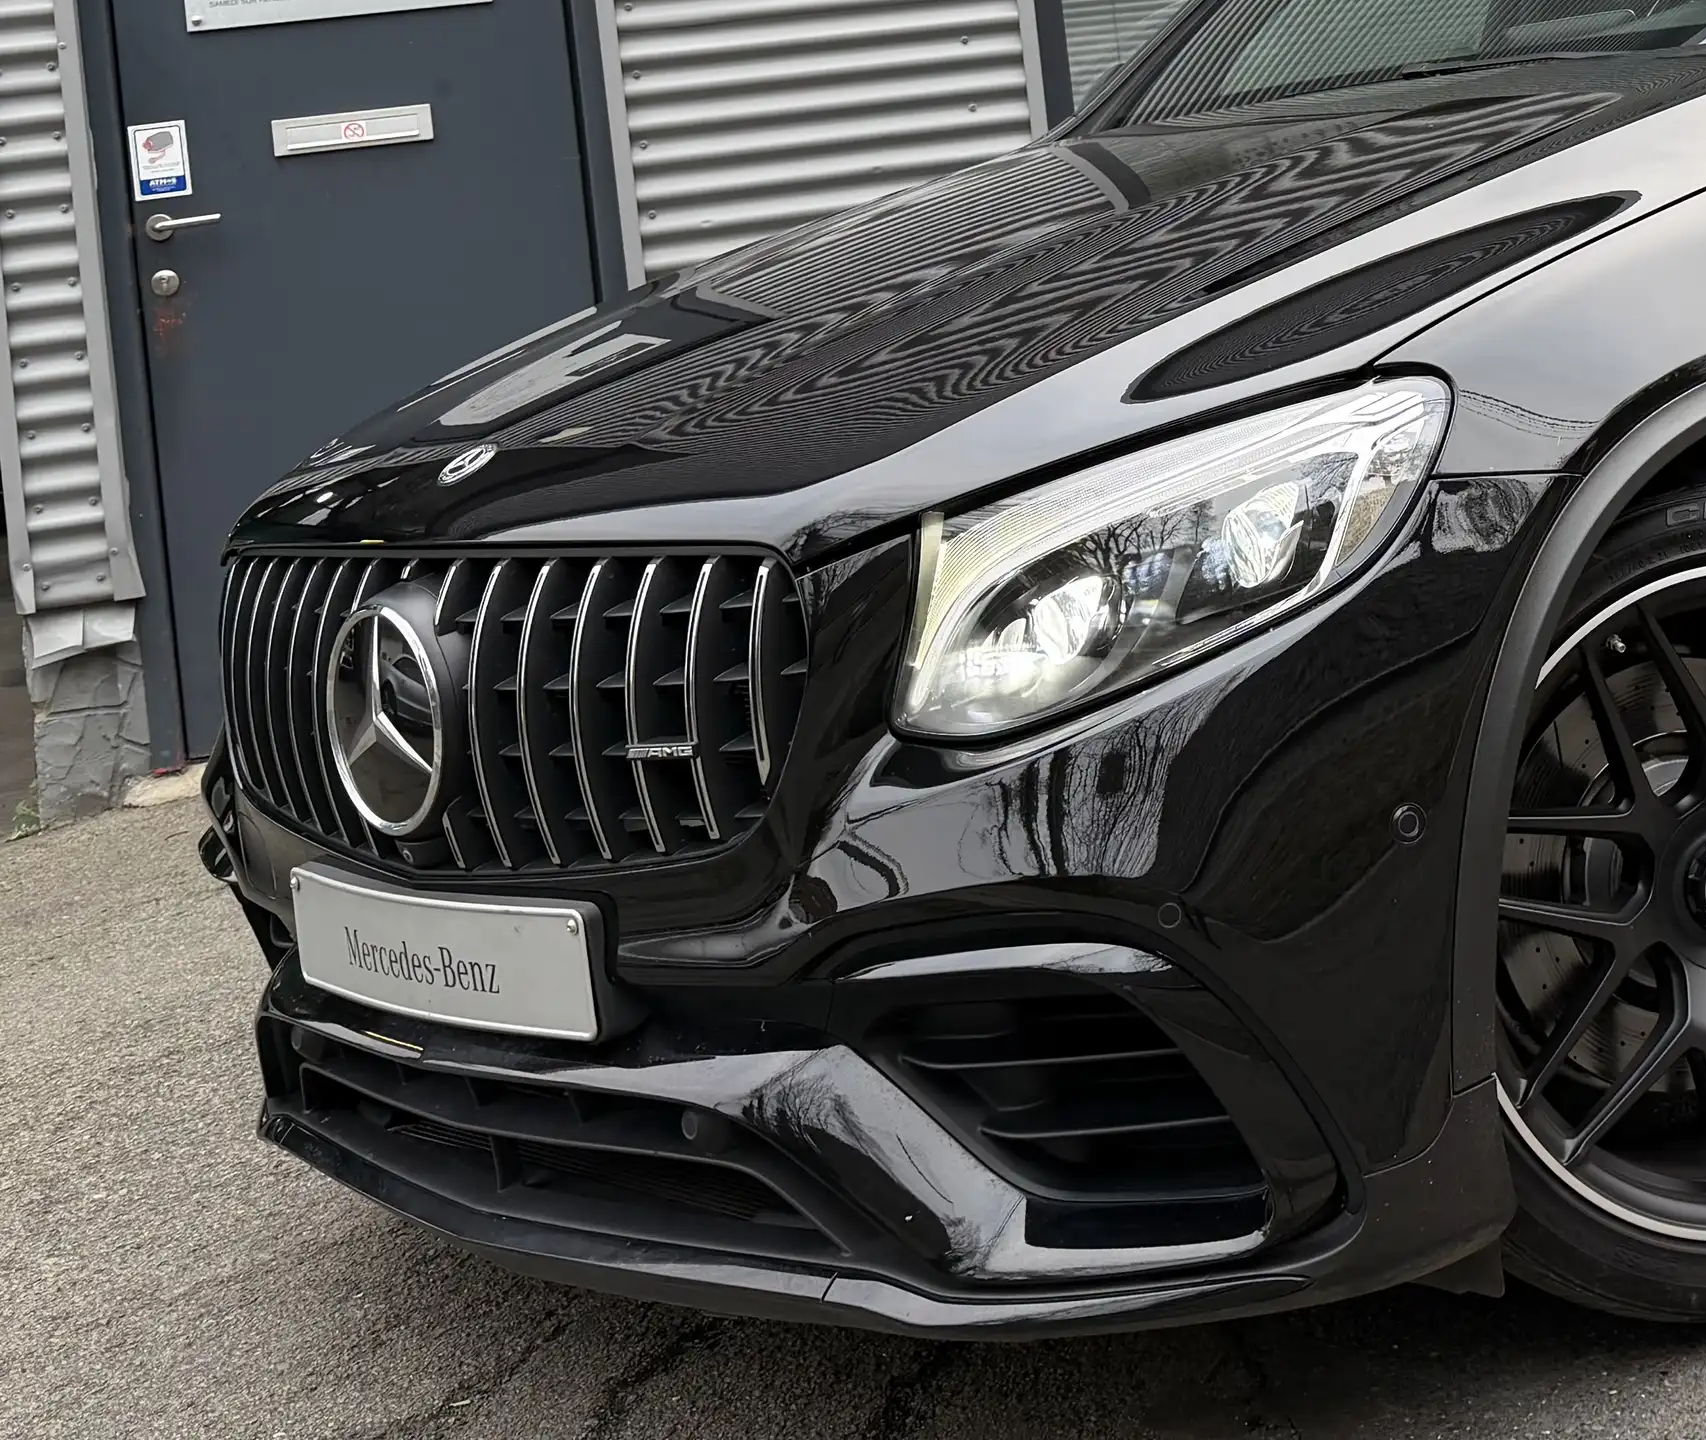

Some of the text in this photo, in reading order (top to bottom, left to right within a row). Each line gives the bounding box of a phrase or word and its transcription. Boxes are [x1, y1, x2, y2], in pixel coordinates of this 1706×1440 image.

[208, 0, 239, 8] SAMEDI
[647, 746, 693, 758] AMG
[344, 926, 500, 994] Mercedes-Benz
